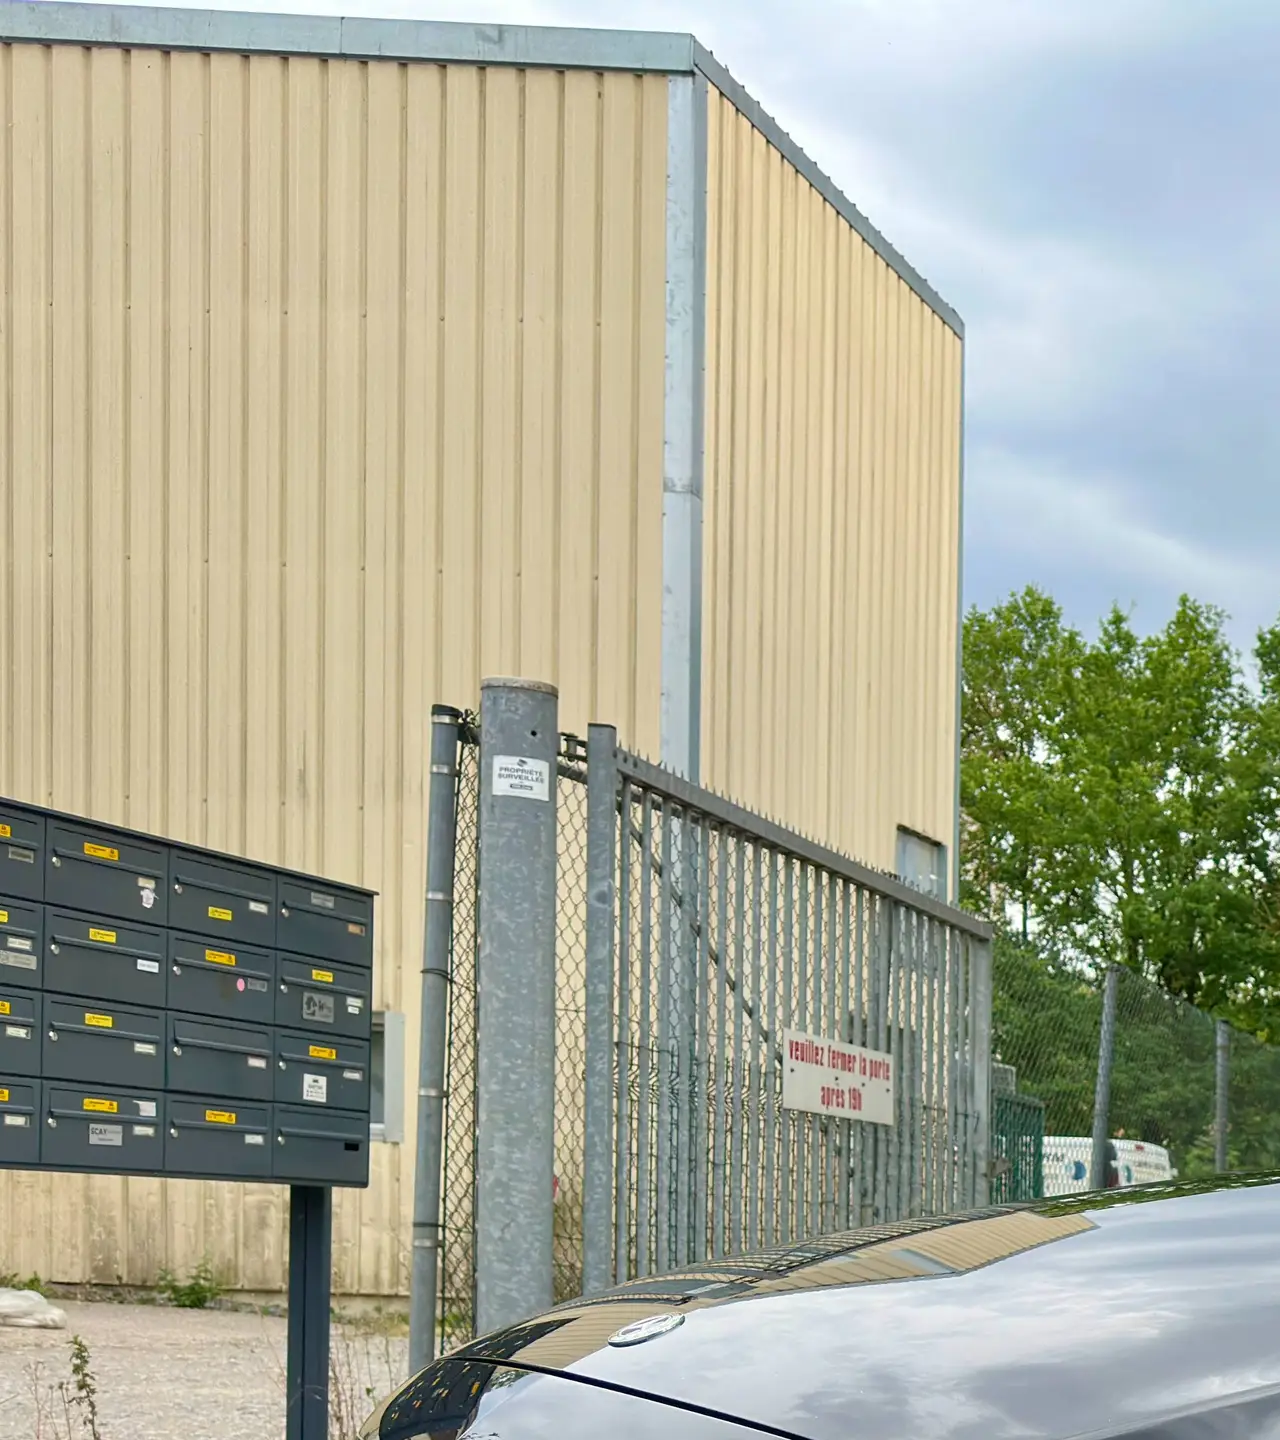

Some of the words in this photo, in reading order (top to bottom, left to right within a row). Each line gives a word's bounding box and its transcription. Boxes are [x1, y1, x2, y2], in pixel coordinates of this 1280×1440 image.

[789, 1038, 824, 1067] veuillez
[828, 1044, 857, 1074] fermer
[859, 1052, 867, 1077] la
[870, 1057, 890, 1081] porte
[849, 1086, 862, 1112] 19h
